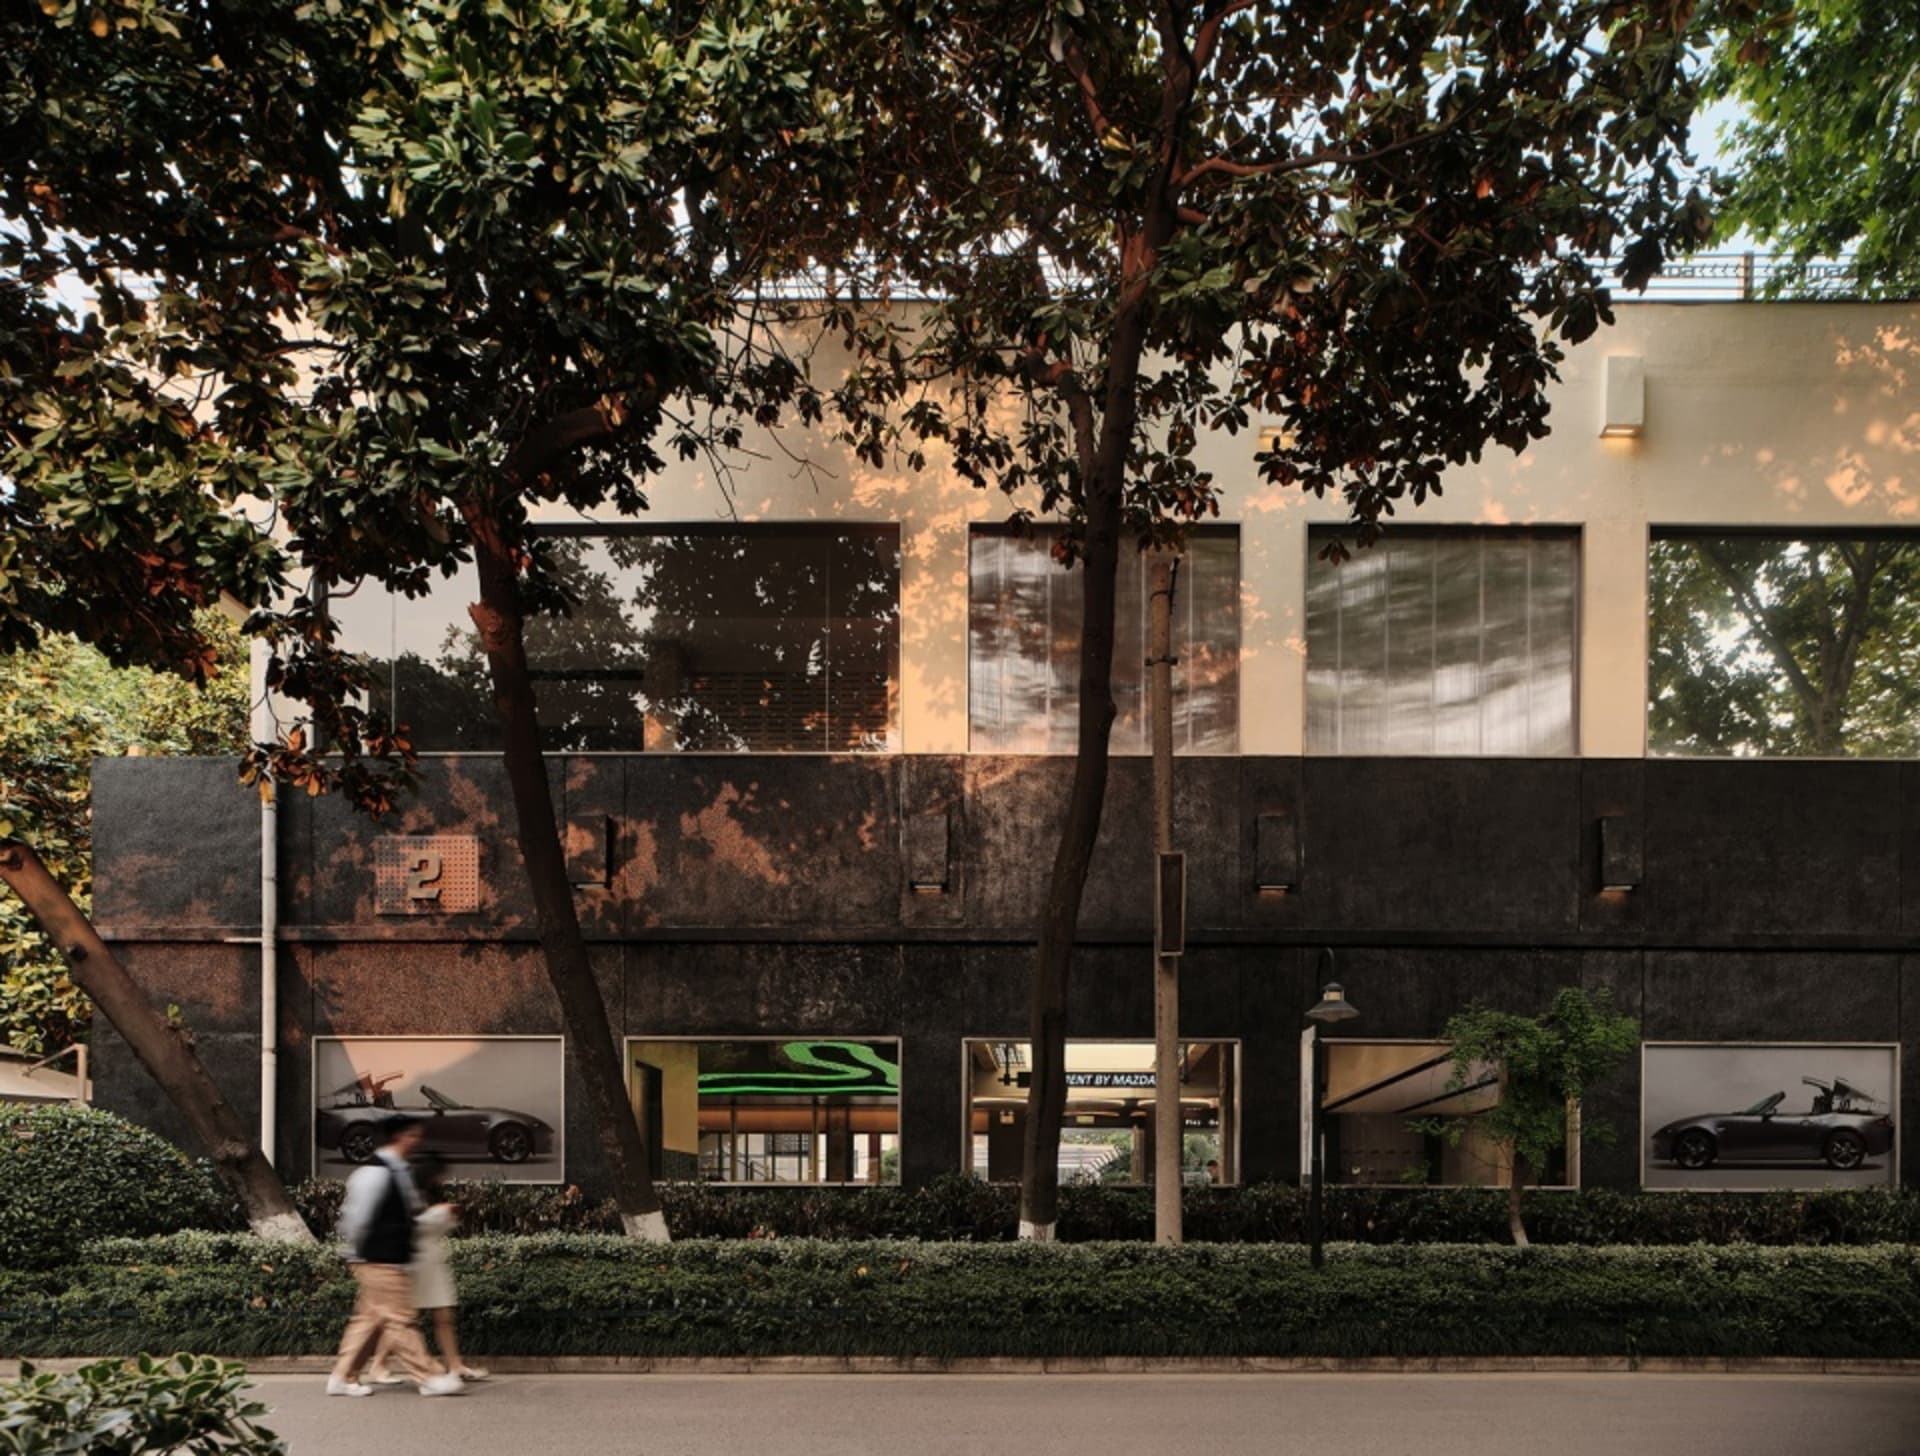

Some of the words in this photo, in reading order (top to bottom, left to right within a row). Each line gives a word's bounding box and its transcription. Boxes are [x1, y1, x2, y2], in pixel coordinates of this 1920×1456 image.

[407, 849, 442, 900] 2
[1093, 1074, 1111, 1085] BY
[1111, 1074, 1156, 1085] MAZDA
